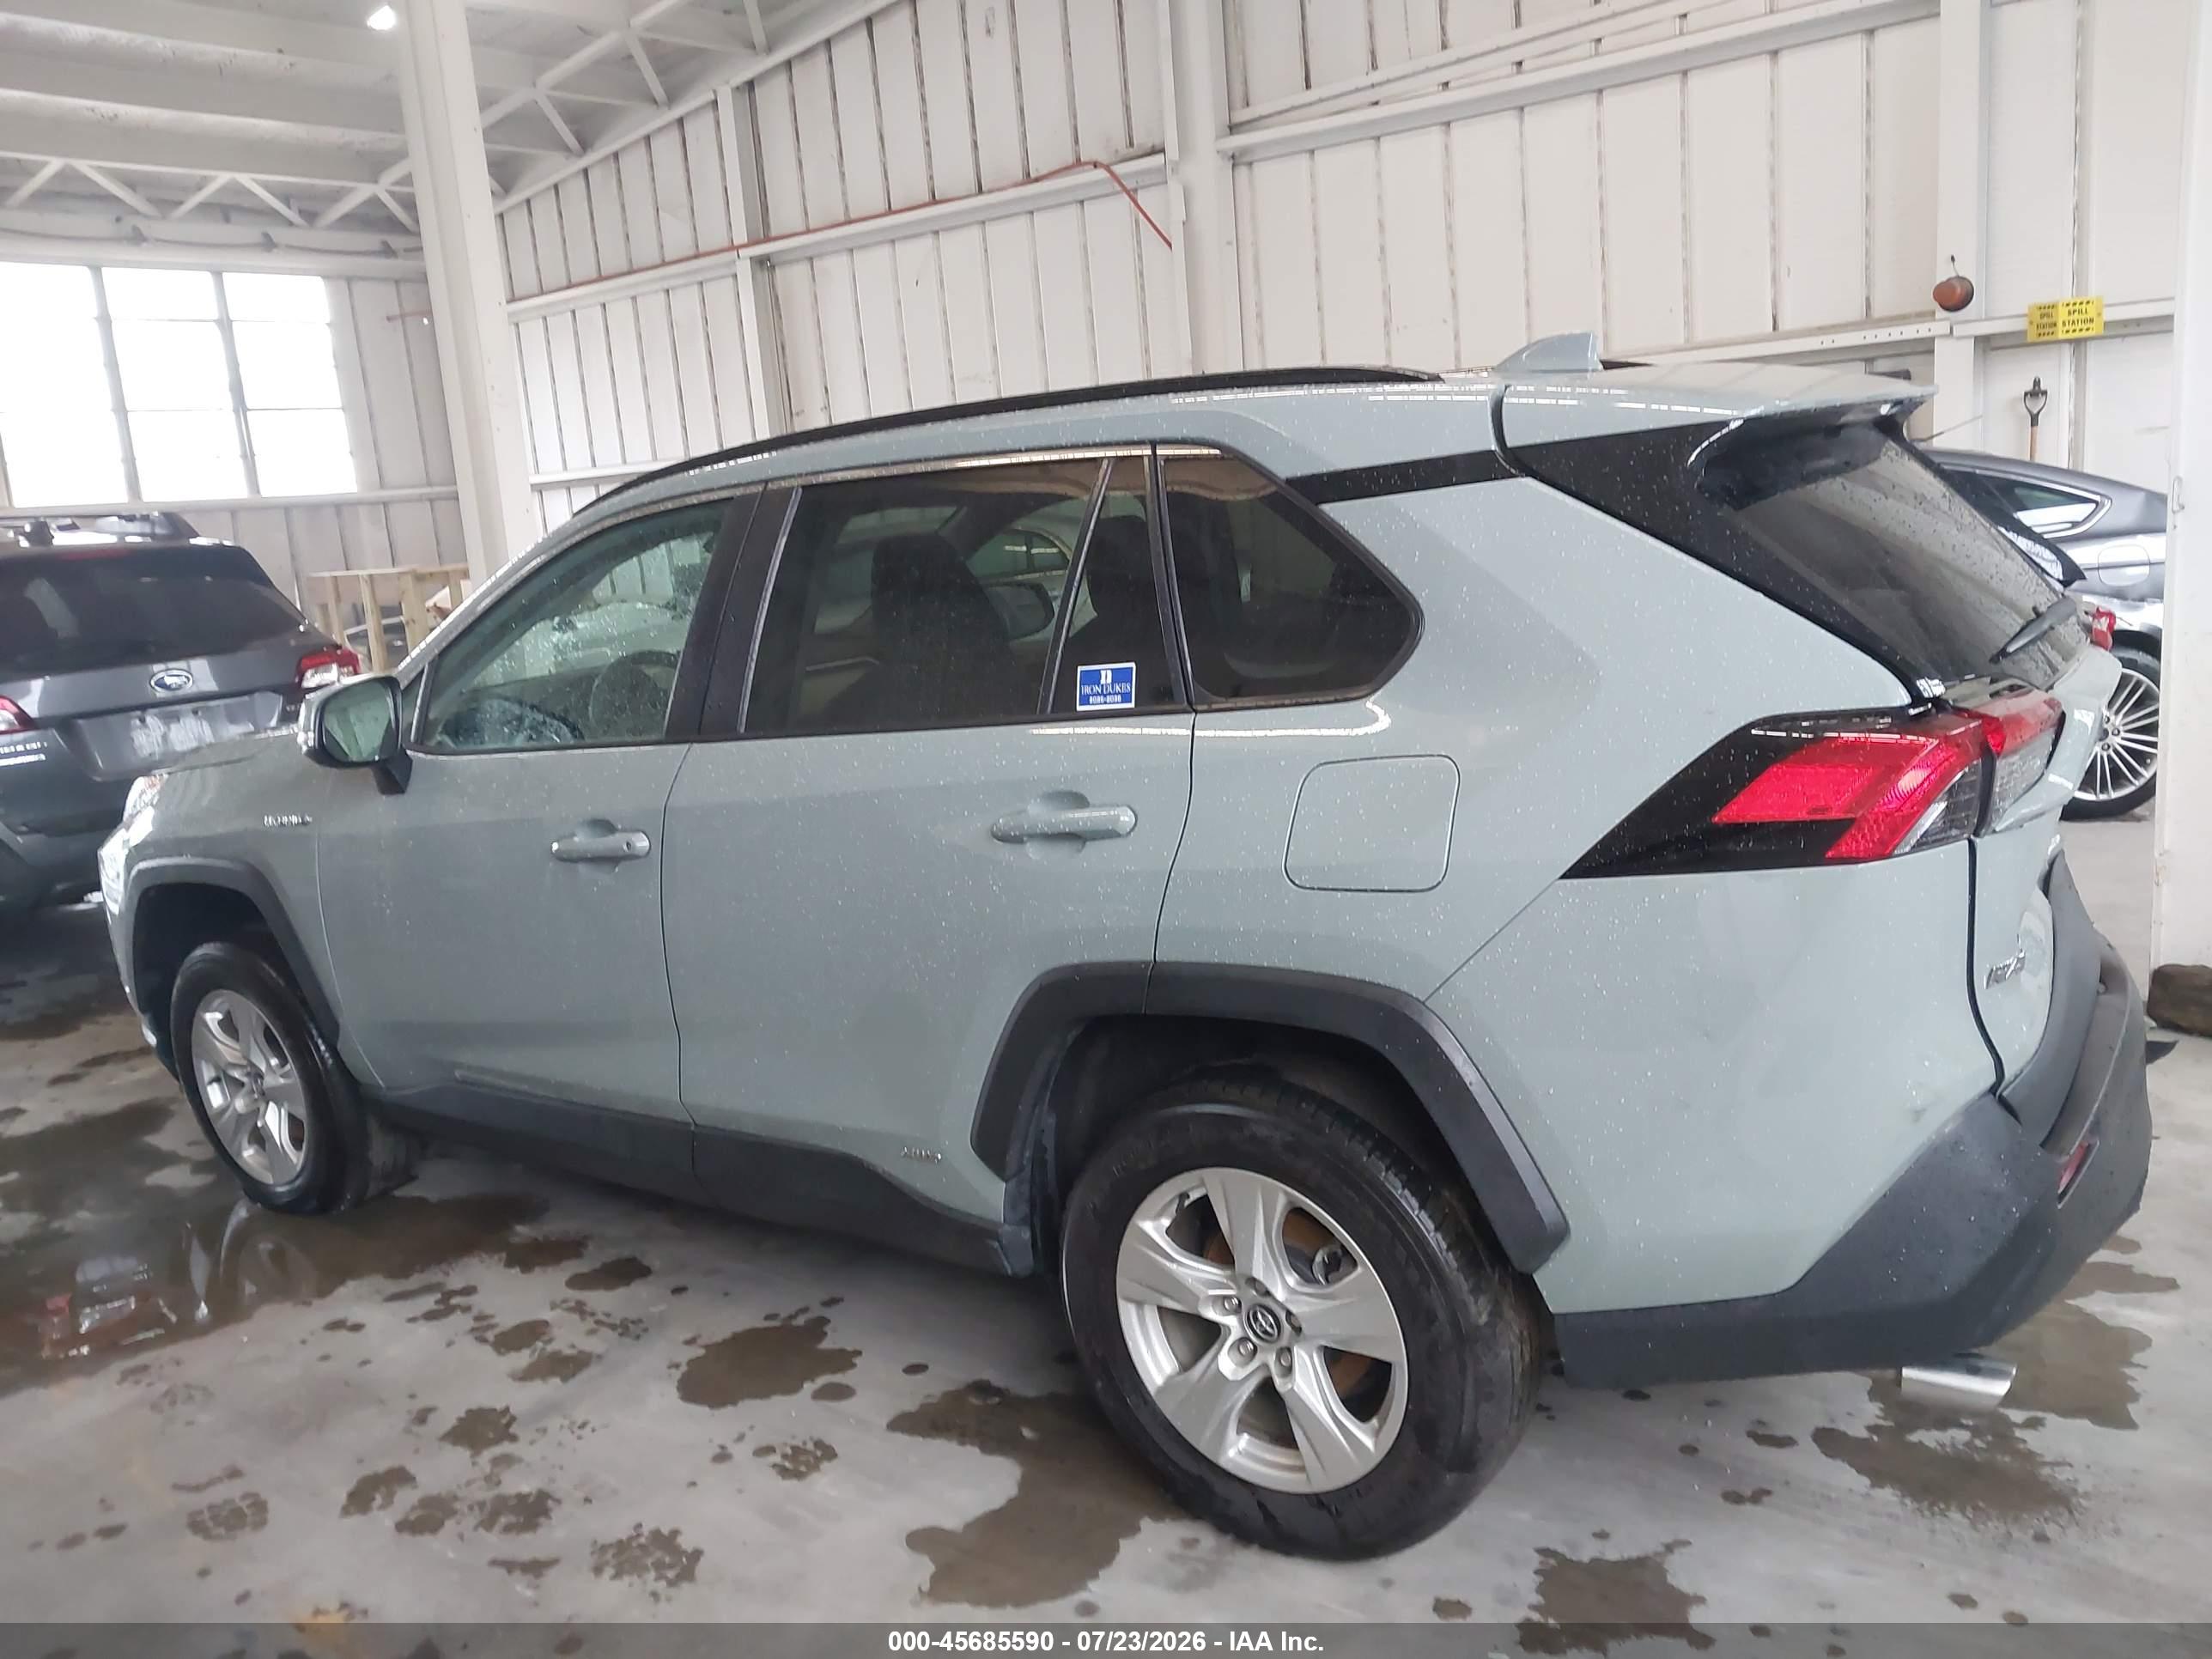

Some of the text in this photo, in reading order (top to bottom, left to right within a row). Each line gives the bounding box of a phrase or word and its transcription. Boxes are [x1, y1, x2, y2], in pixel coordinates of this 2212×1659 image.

[2068, 307, 2088, 317] SPILL
[2062, 317, 2094, 327] STATION
[1081, 682, 1131, 696] IRON DUKES
